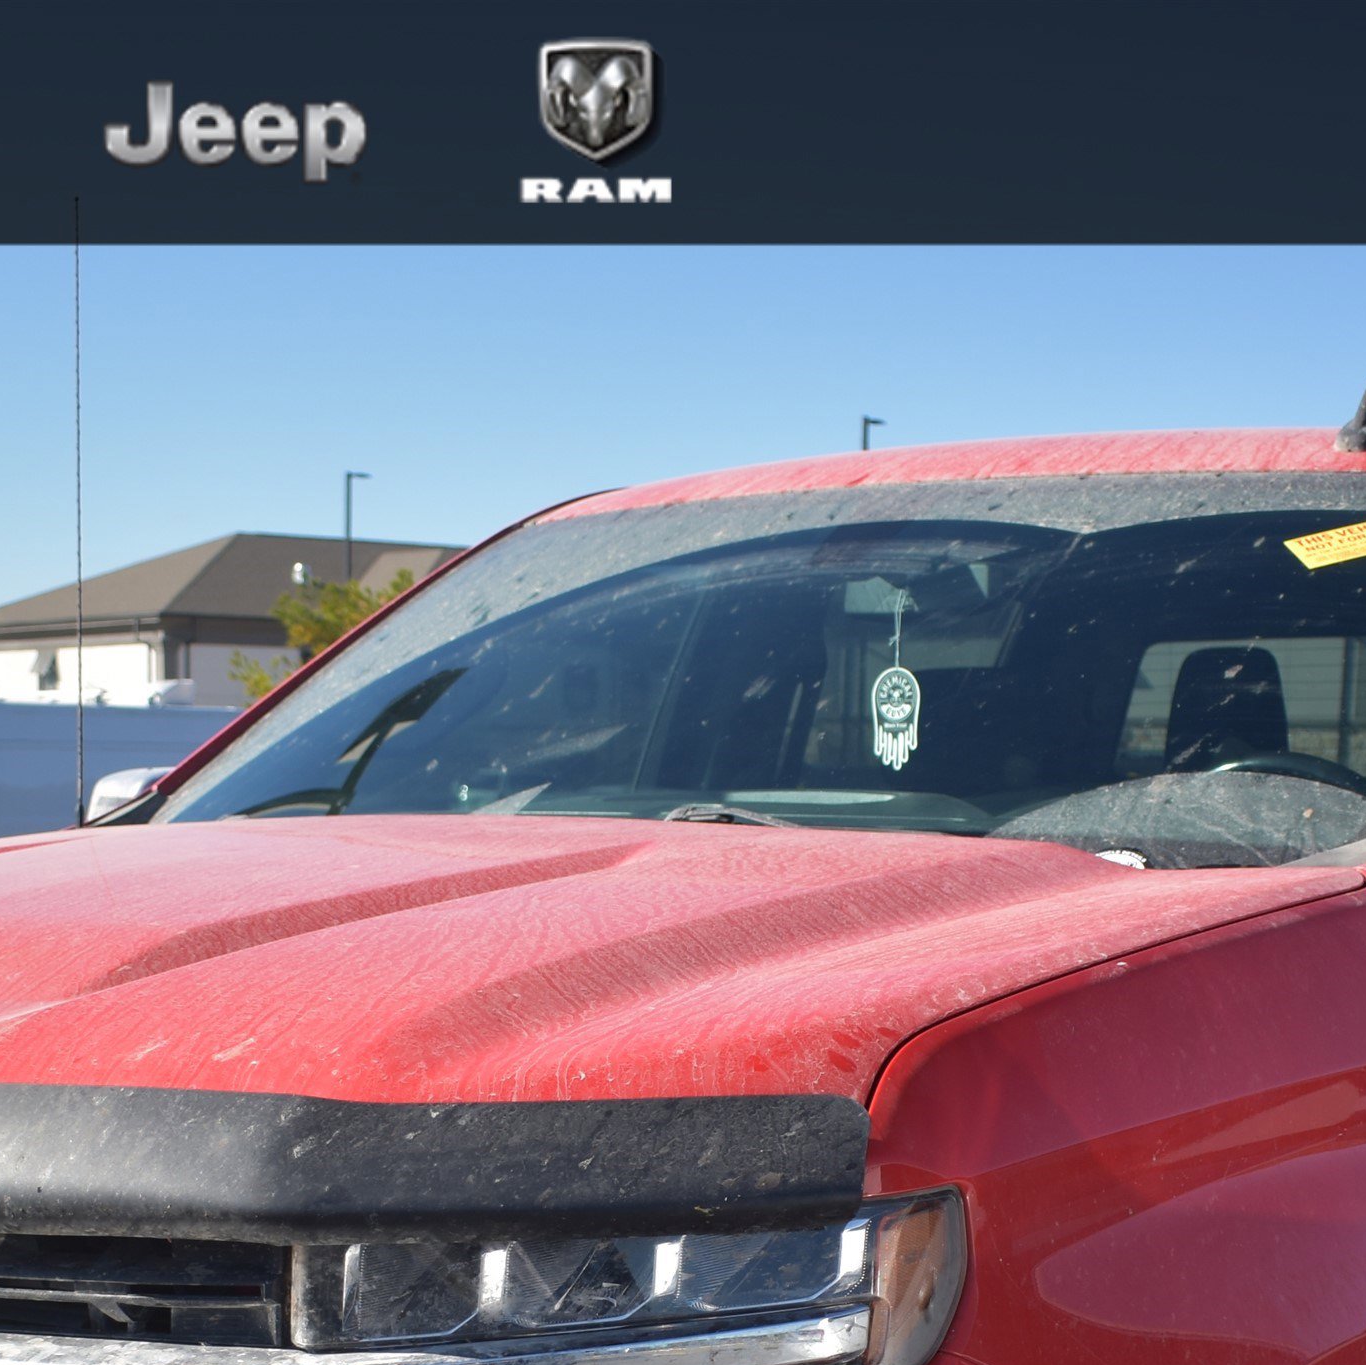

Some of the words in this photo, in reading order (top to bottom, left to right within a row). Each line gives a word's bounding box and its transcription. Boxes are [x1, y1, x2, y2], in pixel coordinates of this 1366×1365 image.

[1295, 532, 1333, 547] THIS
[1305, 542, 1334, 553] NOT
[1338, 533, 1366, 545] FOR
